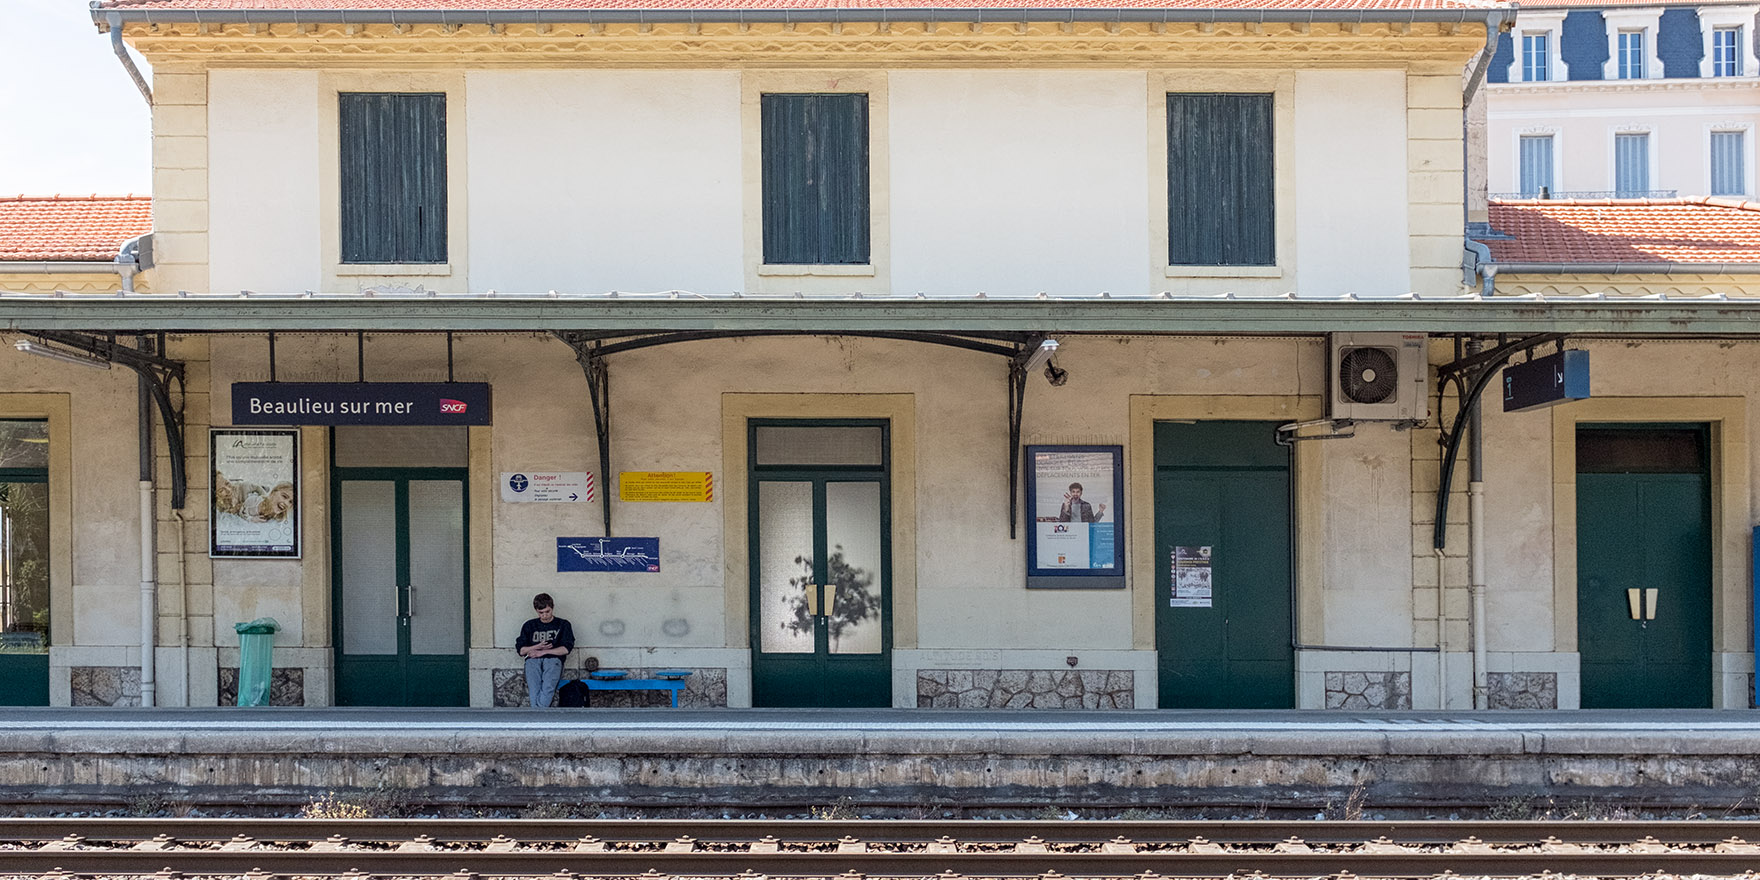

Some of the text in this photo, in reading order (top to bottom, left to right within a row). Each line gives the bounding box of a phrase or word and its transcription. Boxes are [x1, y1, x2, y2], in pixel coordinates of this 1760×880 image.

[250, 397, 414, 414] Beaulieu sur mer
[441, 403, 467, 412] SNCF
[533, 474, 557, 482] Danger
[532, 629, 561, 643] OBEY
